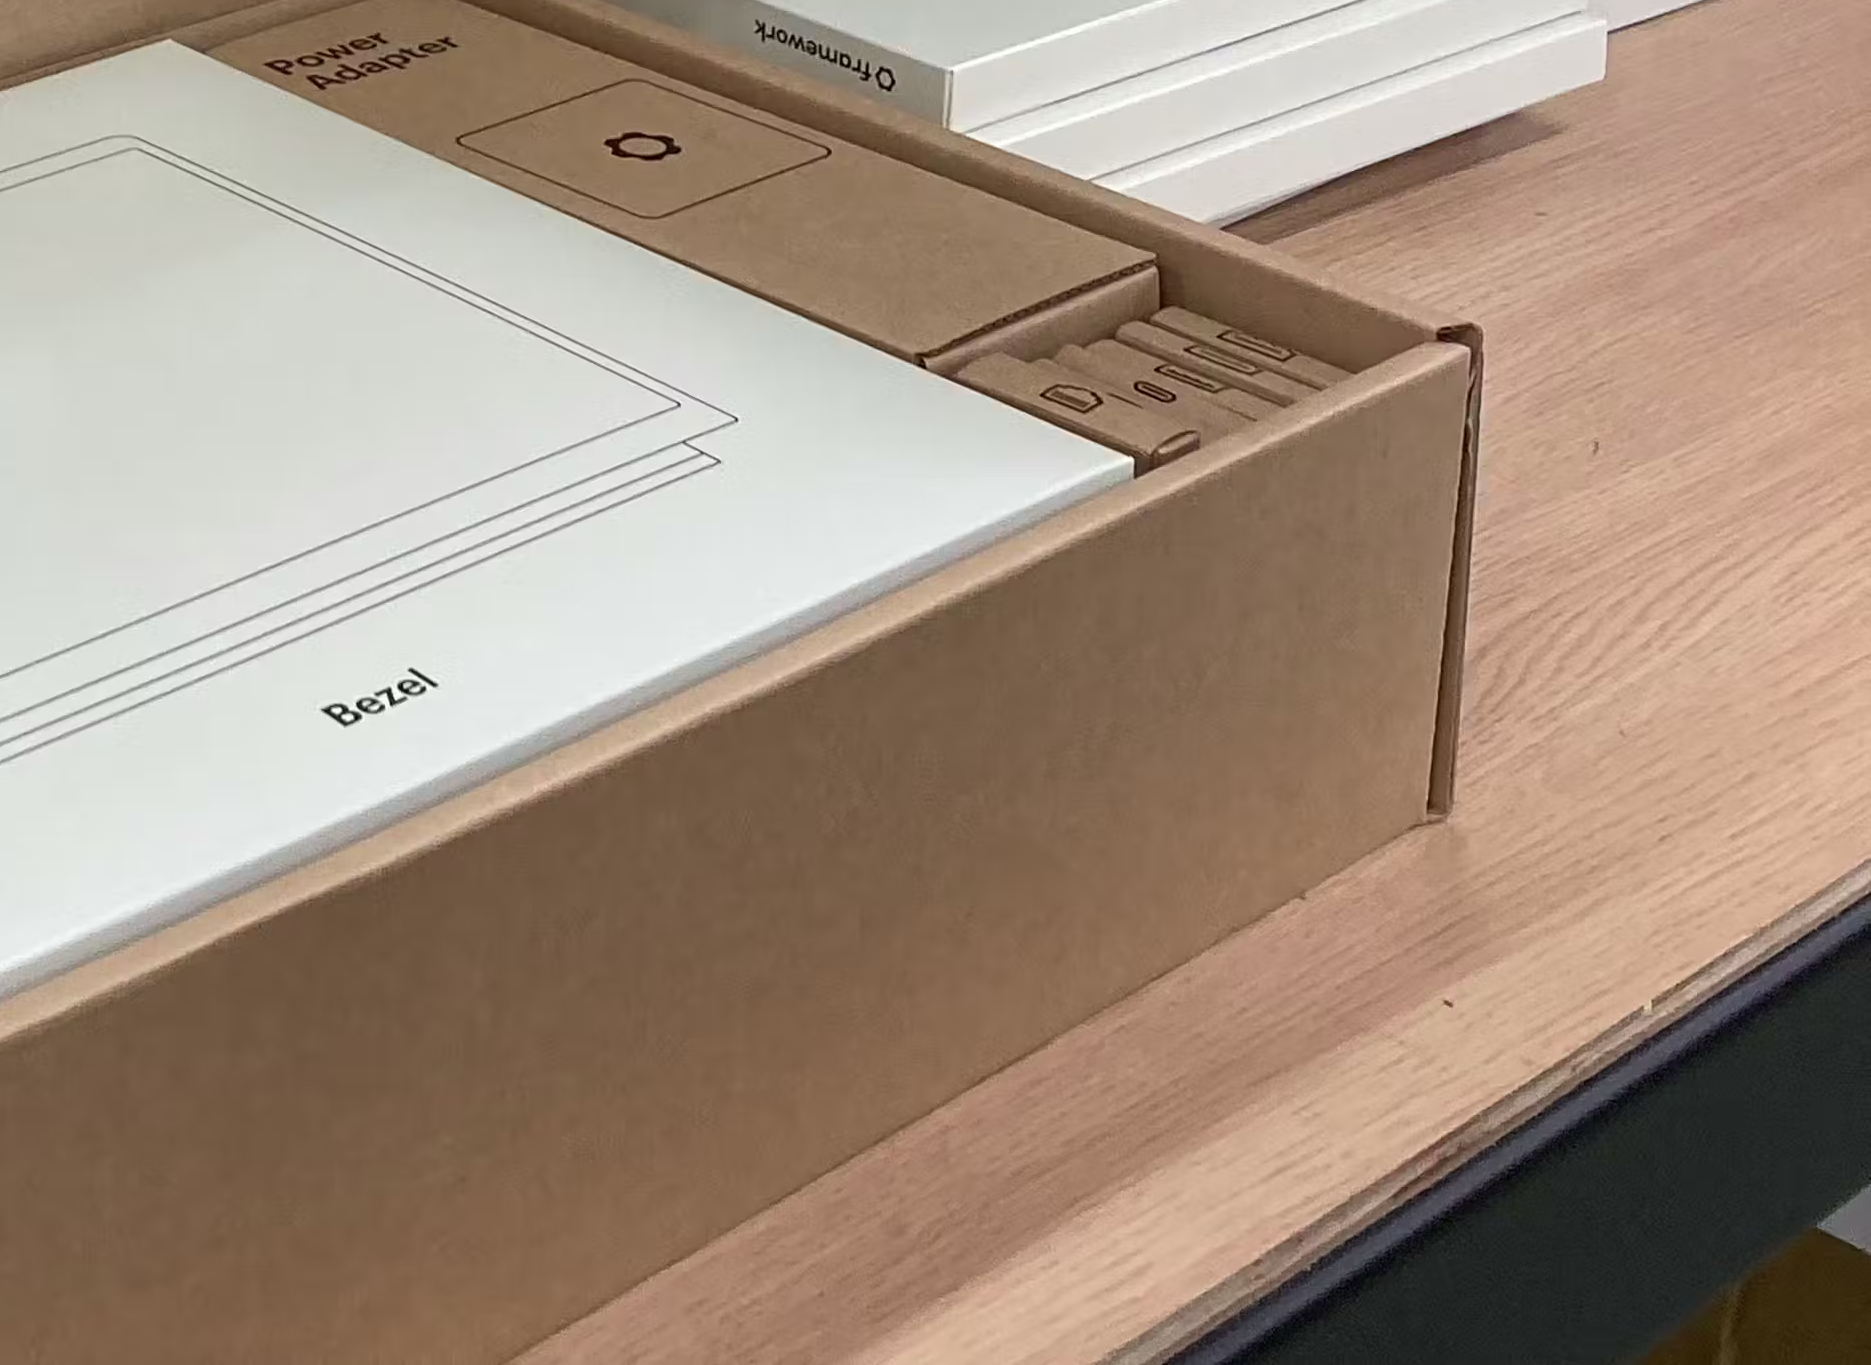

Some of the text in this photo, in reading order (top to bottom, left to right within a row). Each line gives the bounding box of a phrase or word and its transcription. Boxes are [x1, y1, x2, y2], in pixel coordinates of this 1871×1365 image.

[263, 32, 389, 75] Power
[306, 36, 460, 90] Adapter
[754, 19, 871, 81] framework
[321, 667, 438, 727] Bezel
